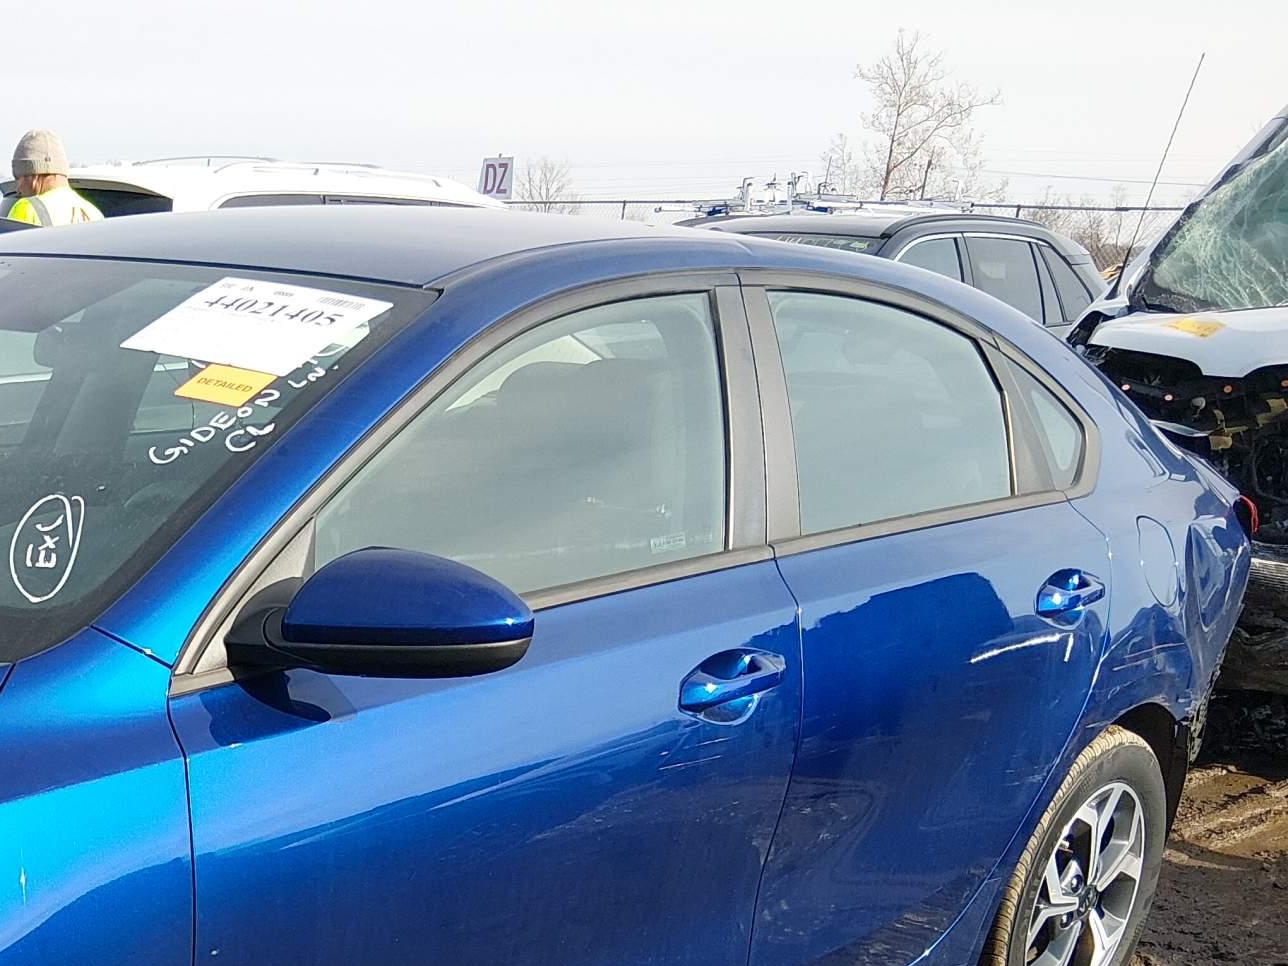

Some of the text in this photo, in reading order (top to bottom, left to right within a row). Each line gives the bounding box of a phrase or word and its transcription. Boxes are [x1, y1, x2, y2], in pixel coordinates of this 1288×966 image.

[483, 162, 509, 194] DZ
[204, 294, 345, 328] 44021405
[196, 376, 254, 394] DETAILED
